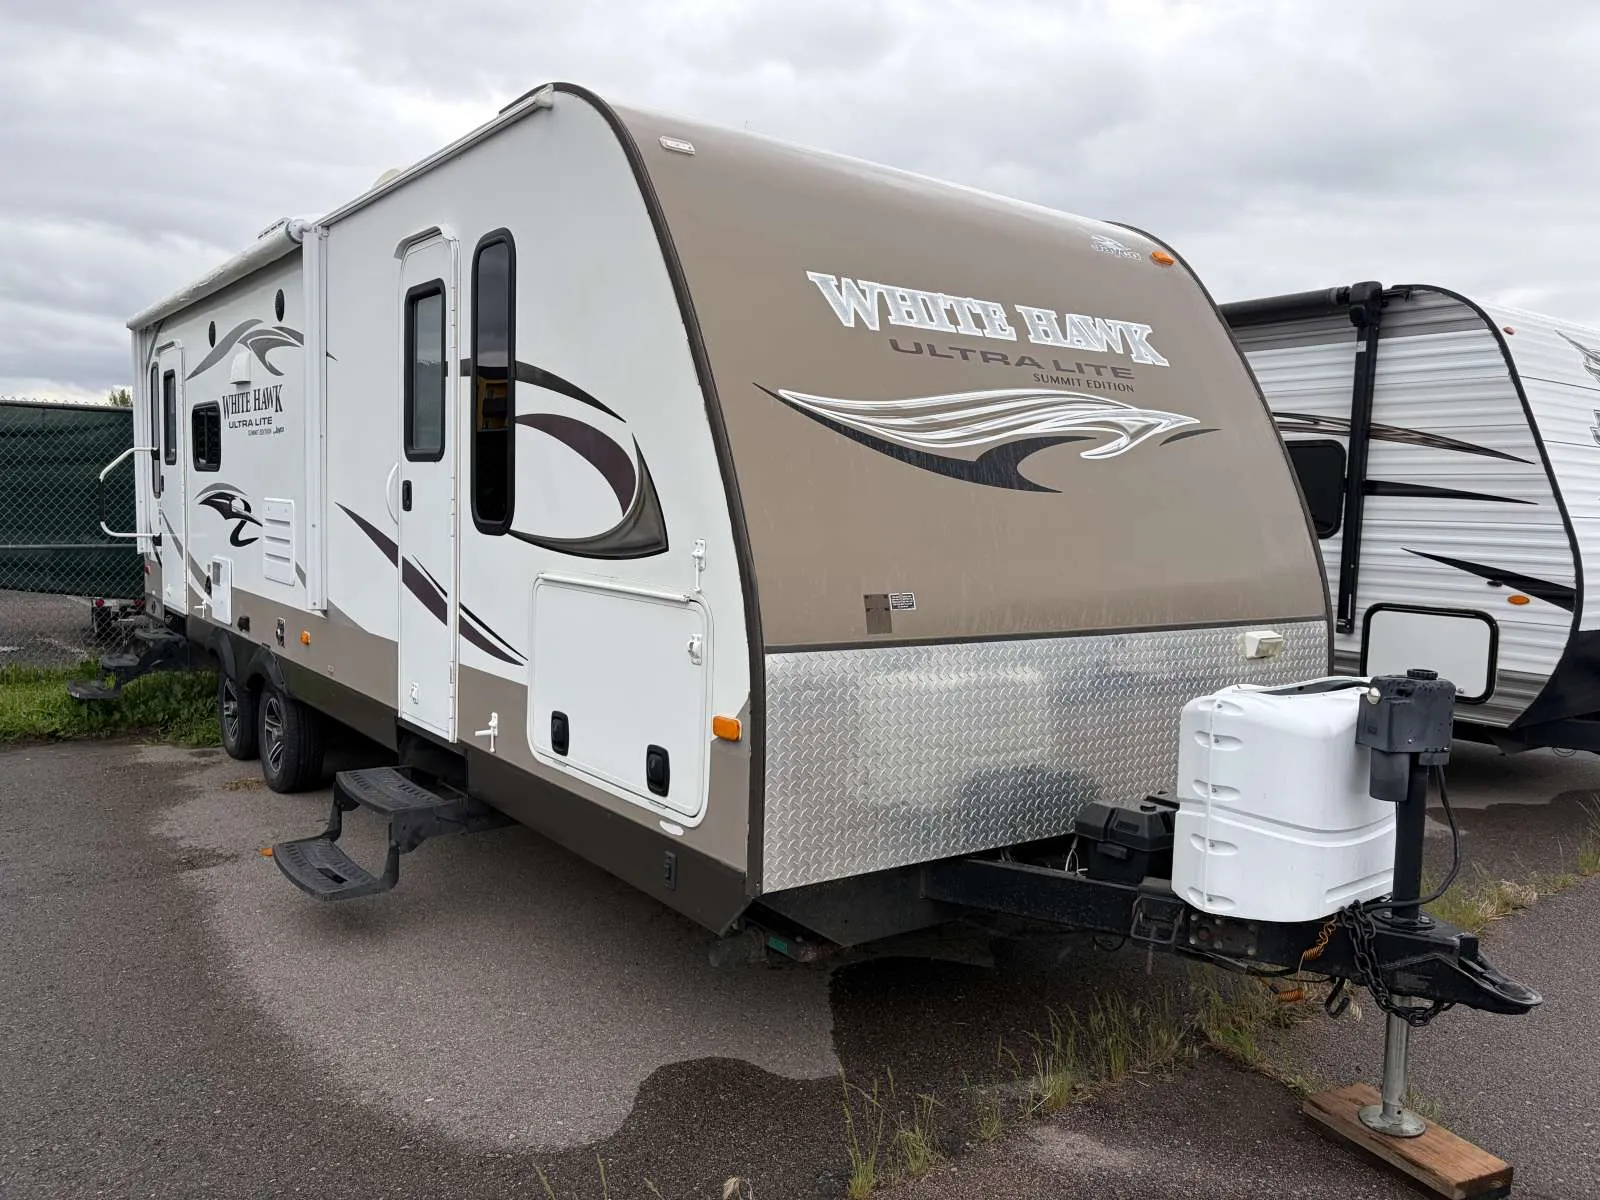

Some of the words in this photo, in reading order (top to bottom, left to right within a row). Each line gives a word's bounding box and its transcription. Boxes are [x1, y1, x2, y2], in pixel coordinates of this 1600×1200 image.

[806, 270, 1015, 341] WHITE
[1015, 304, 1170, 367] HAWK
[889, 338, 1044, 369] ULTRA
[1052, 359, 1135, 379] LITE
[1033, 373, 1081, 387] SUMMIT
[1086, 379, 1134, 393] EDITION
[222, 391, 251, 420] WHITE
[253, 384, 283, 413] HAWK
[228, 419, 254, 429] ULTRA
[254, 416, 273, 427] LITE
